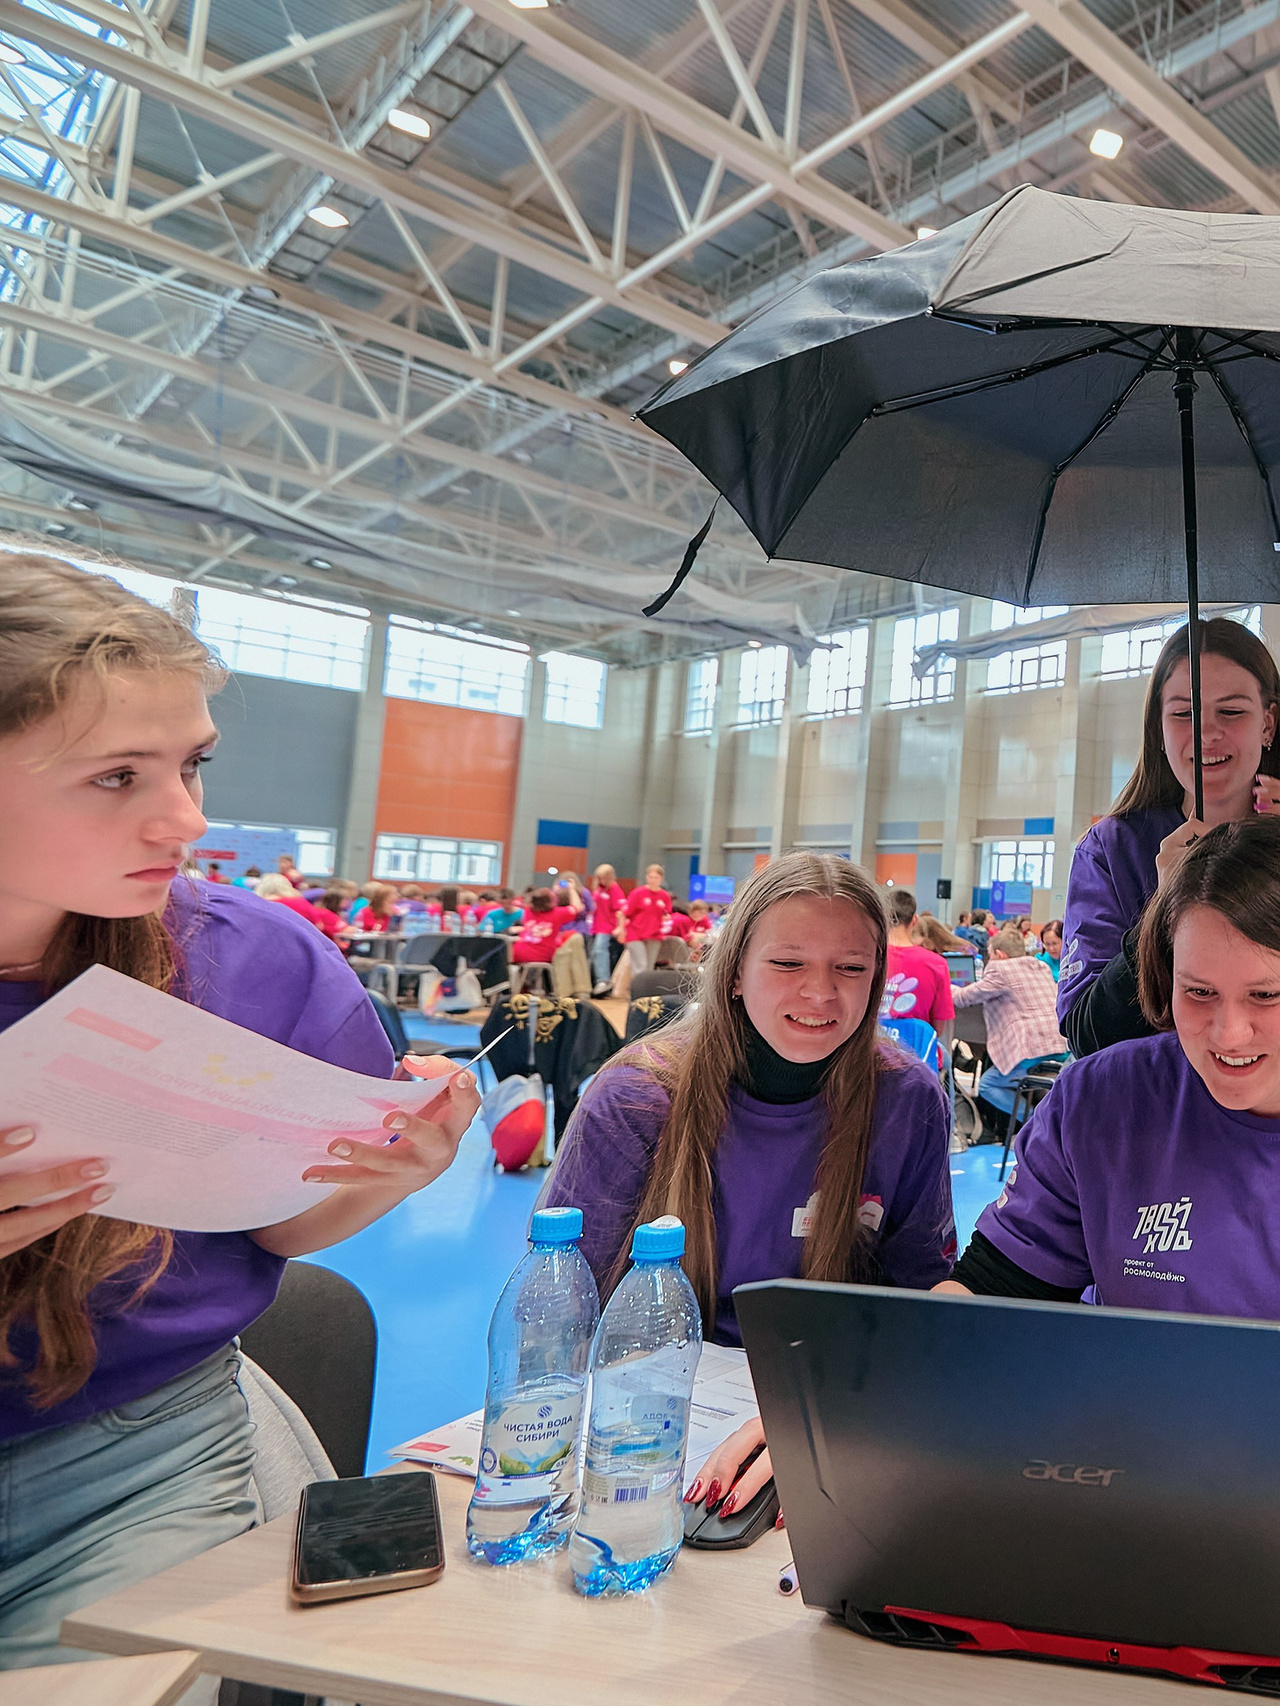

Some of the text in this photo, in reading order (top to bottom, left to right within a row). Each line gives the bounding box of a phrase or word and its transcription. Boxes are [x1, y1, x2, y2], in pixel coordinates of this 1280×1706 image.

[1124, 1259, 1145, 1267] проект
[1123, 1267, 1185, 1282] росмолодёжь
[504, 1415, 573, 1433] ЧИСТАЯ ВОДА
[516, 1429, 560, 1443] СИБИРИ
[1022, 1459, 1126, 1487] acer
